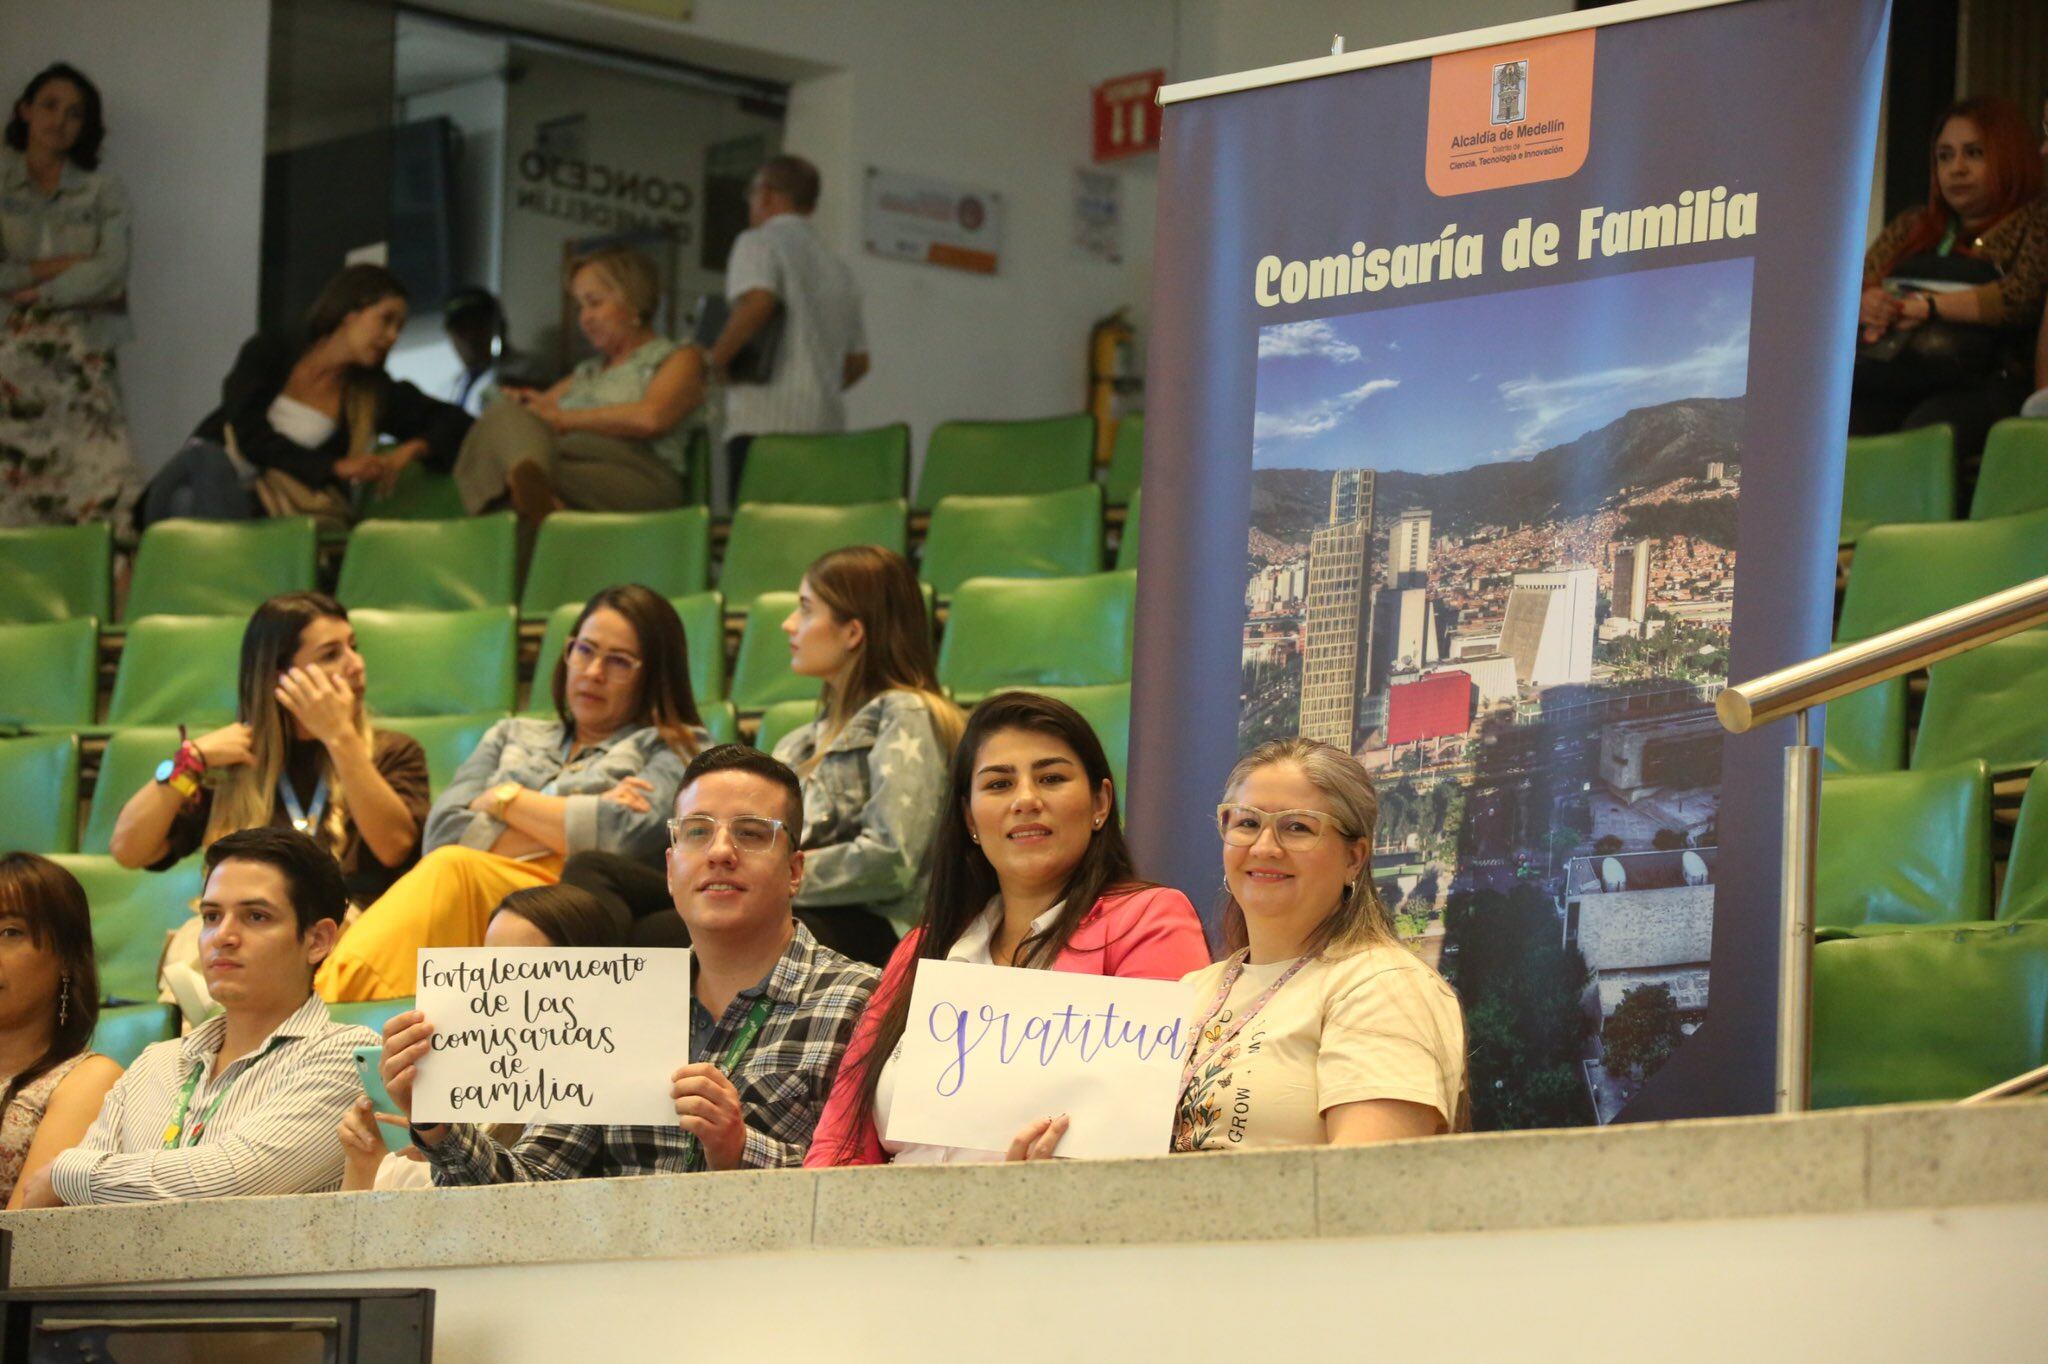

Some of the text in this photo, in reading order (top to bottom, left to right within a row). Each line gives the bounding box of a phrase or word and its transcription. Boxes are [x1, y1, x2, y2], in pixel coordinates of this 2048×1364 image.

[1451, 119, 1565, 149] Alcaldía de Medellín
[1450, 159, 1477, 170] Ciencia,
[1524, 146, 1563, 159] Innovación
[1254, 185, 1759, 308] Comisaría de Familia
[470, 989, 577, 1030] de las
[490, 1055, 529, 1078] de
[928, 1001, 1187, 1097] gratitud
[450, 1068, 593, 1111] familia
[1227, 1087, 1251, 1143] GROW
